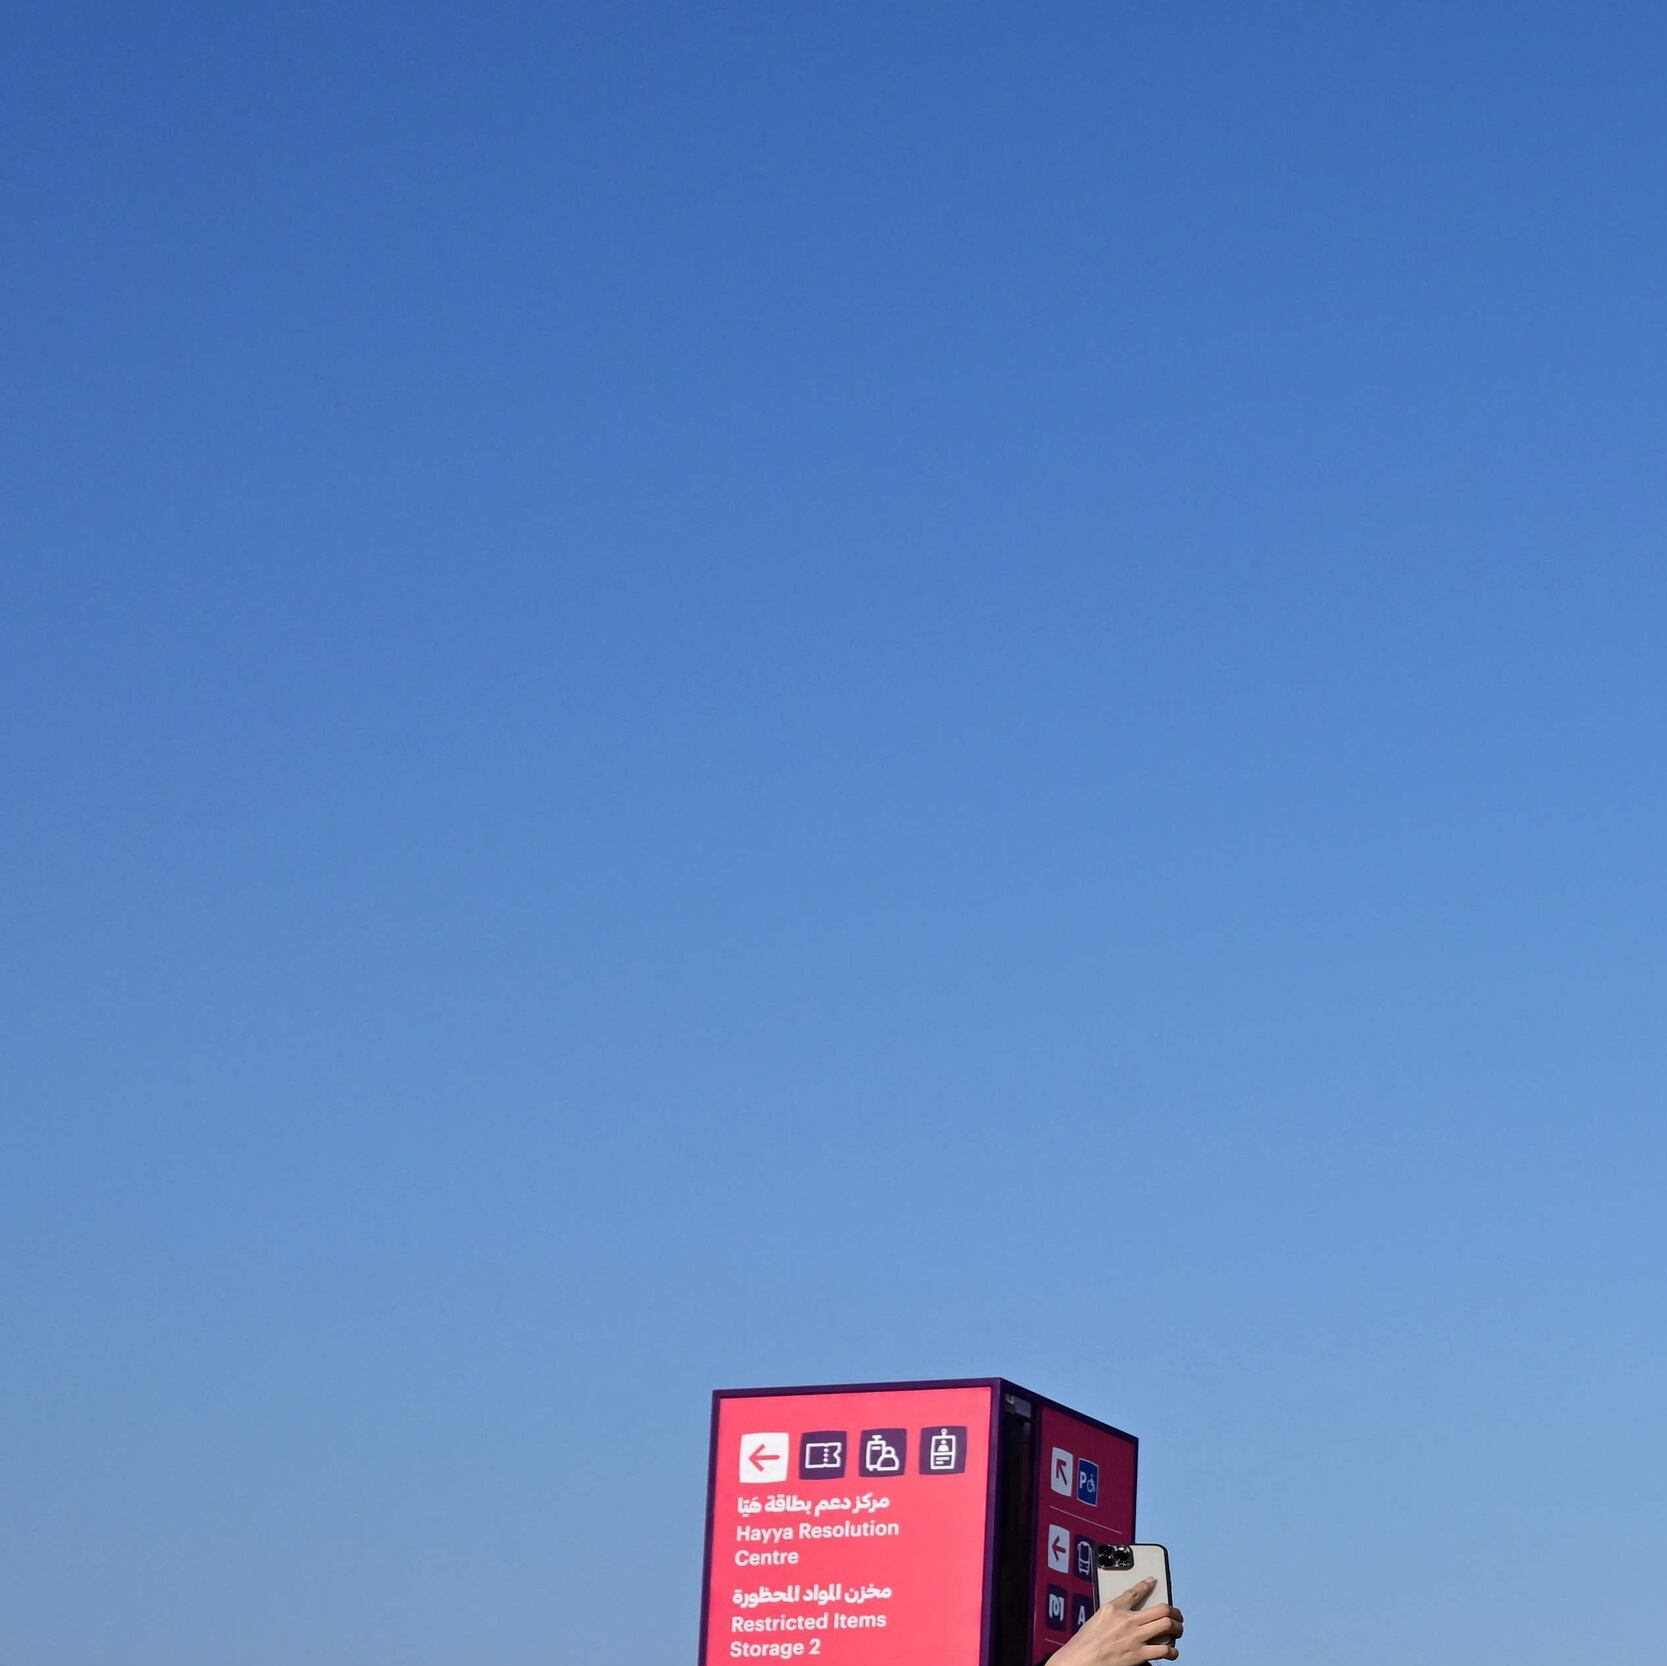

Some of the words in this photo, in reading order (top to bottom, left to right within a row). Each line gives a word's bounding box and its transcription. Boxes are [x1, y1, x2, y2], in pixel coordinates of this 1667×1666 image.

[765, 1494, 812, 1515] بطاقة
[814, 1496, 851, 1517] دعم
[852, 1492, 890, 1513] مركز
[736, 1525, 793, 1544] Hayya
[799, 1520, 899, 1540] Resolution
[734, 1550, 799, 1567] Centre
[732, 1585, 800, 1609] المحظورة
[802, 1583, 842, 1605] المواد
[844, 1583, 892, 1604] مخزن
[731, 1612, 829, 1633] Restricted
[834, 1612, 887, 1629] Items
[730, 1640, 804, 1660] Storage
[808, 1638, 821, 1655] 2
